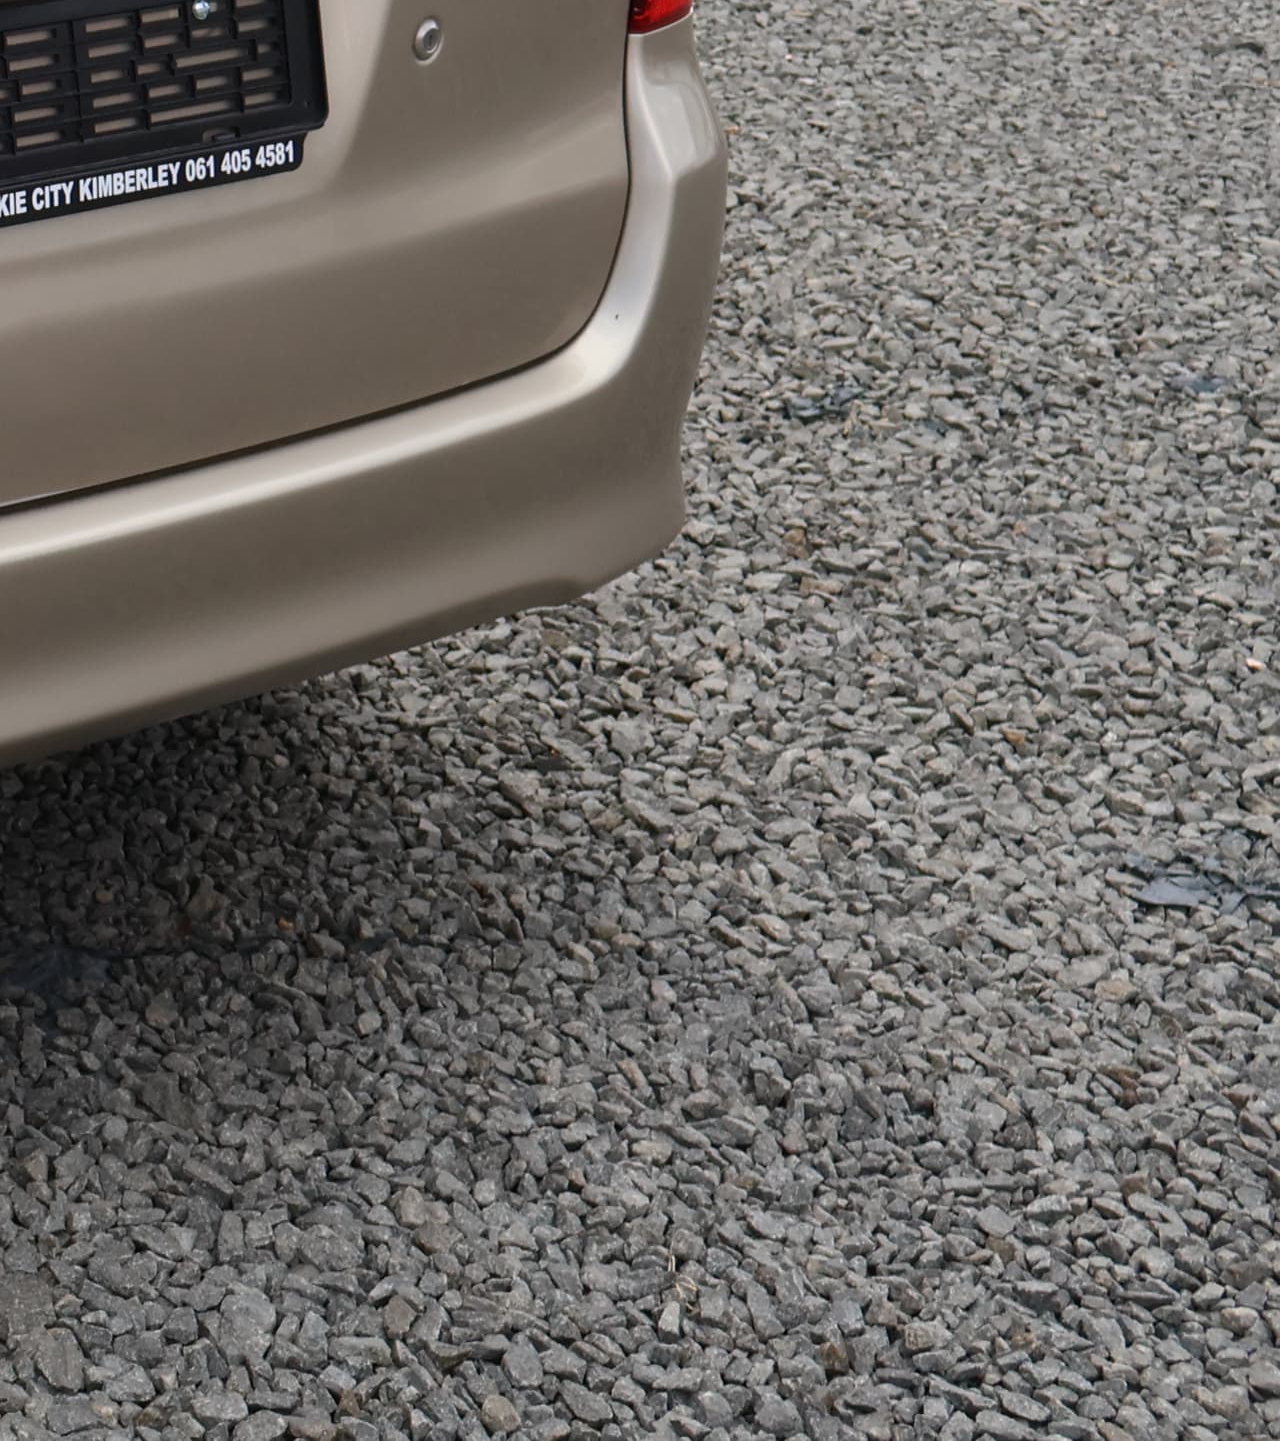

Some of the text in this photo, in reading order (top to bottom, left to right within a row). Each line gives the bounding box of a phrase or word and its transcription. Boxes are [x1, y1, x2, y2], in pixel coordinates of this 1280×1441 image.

[32, 181, 74, 210] CITY
[79, 162, 180, 202] KIMBERLEY
[185, 155, 215, 182] 061
[220, 148, 251, 175] 405
[255, 140, 294, 168] 4581
